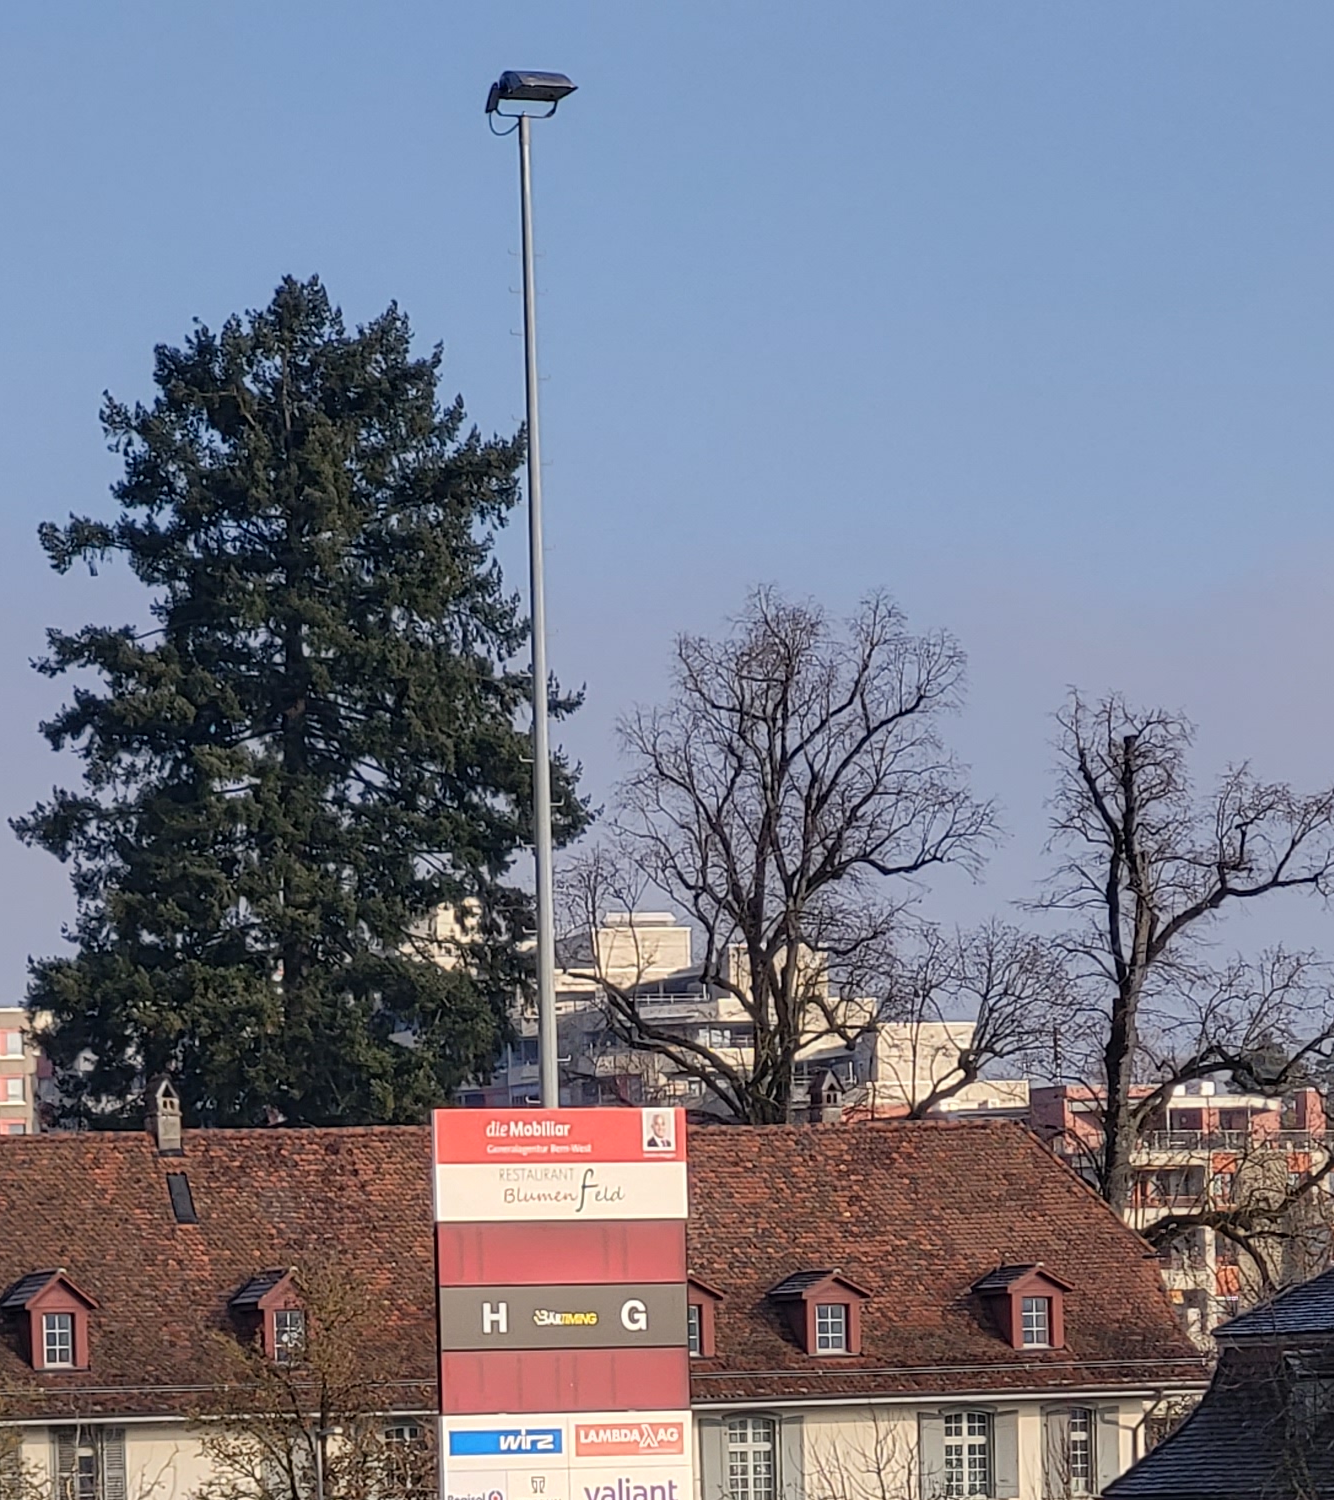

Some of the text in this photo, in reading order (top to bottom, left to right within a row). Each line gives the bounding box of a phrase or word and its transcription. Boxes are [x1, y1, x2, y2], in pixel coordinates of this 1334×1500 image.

[486, 1143, 549, 1156] Generalagentur
[499, 1167, 575, 1182] RESTAURANT
[482, 1302, 508, 1334] H
[621, 1299, 648, 1331] G
